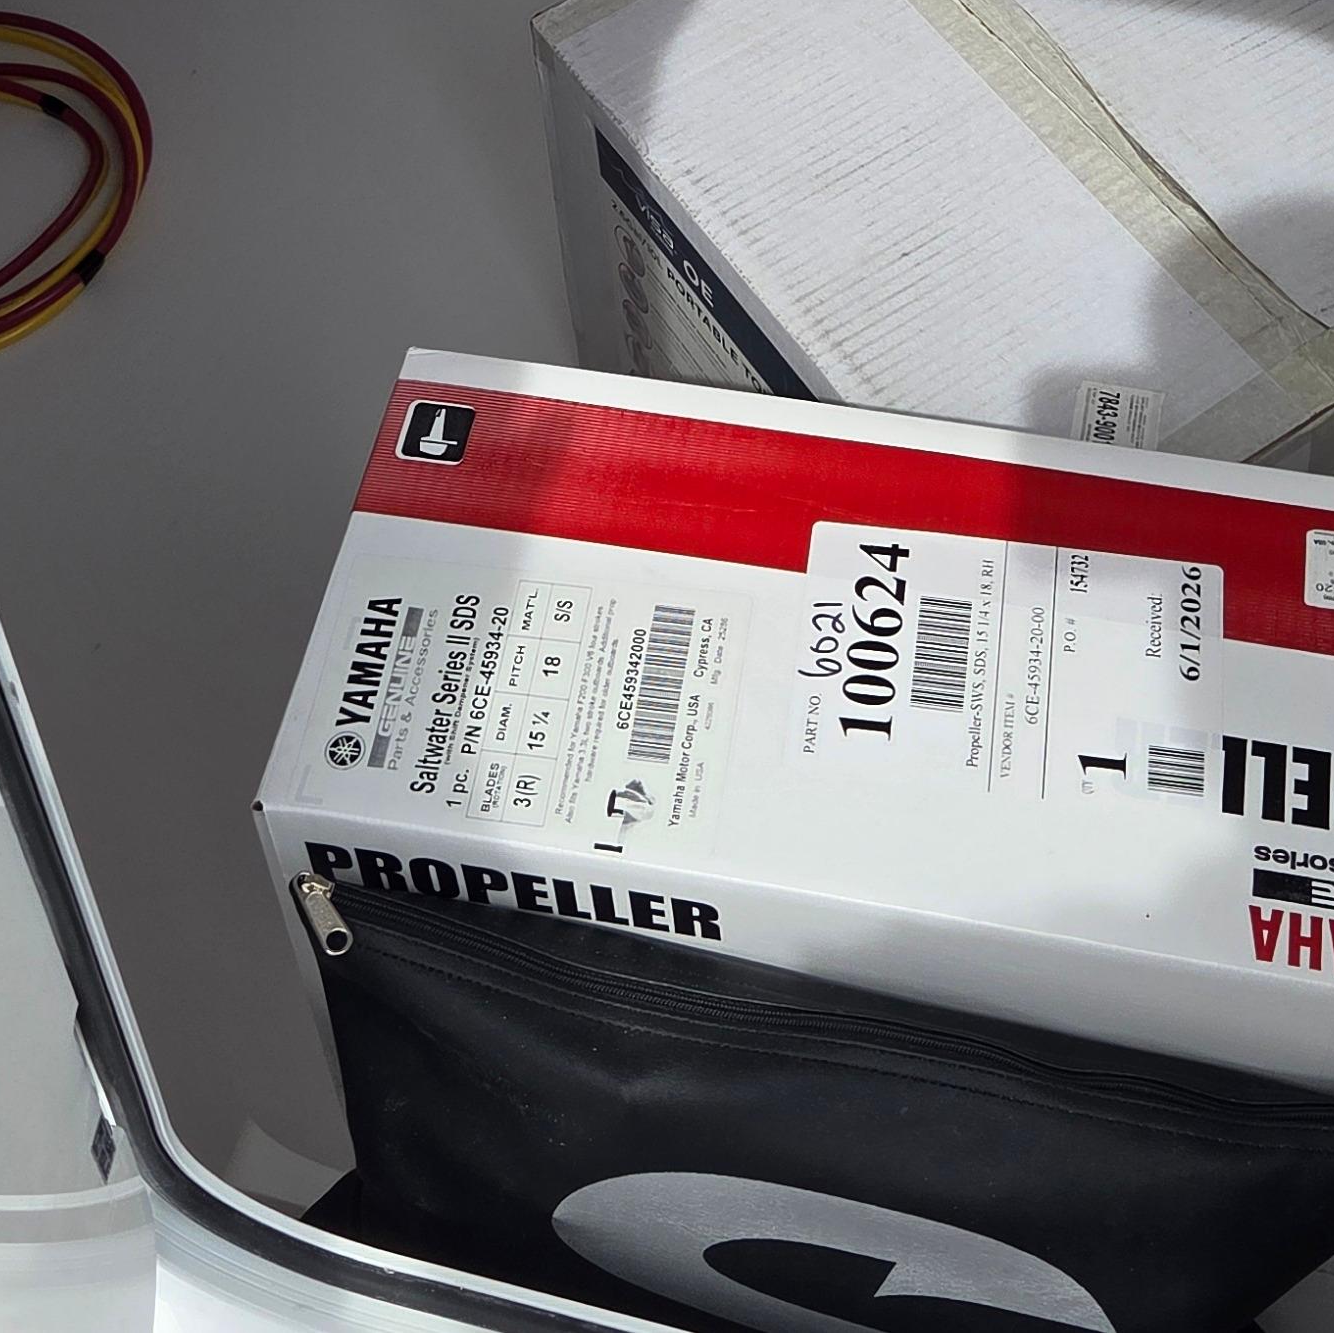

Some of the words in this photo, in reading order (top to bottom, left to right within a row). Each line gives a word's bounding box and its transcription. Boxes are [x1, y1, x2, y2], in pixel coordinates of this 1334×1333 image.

[667, 267, 737, 361] PORTABLE
[981, 559, 995, 577] RH
[1069, 553, 1088, 593] 154732
[449, 594, 481, 630] SDS
[553, 599, 573, 622] S/S
[700, 617, 712, 632] CA
[977, 609, 991, 625] 1/4
[1145, 592, 1163, 658] Received:
[1178, 565, 1202, 681] 6/1/2026
[445, 634, 471, 645] II
[798, 598, 843, 680] 6021
[836, 539, 910, 741] 100624
[975, 630, 988, 642] 15
[1063, 628, 1077, 652] P.O.
[335, 597, 403, 727] YAMAHA
[405, 609, 438, 707] Accessories
[469, 606, 509, 720] 6CE-45934-20
[508, 645, 525, 686] PITCH
[541, 655, 560, 677] 18
[692, 634, 711, 678] Cypress,
[972, 646, 989, 675] SDS,
[1023, 606, 1045, 725] 6CE-45934-20-00
[378, 636, 417, 736] GENUINE
[431, 650, 467, 704] Series
[615, 627, 647, 729] 6CE459342000
[401, 711, 412, 724] &
[495, 702, 512, 740] DIAM.
[686, 694, 700, 716] USA
[807, 692, 821, 715] NO.
[966, 678, 986, 767] Propeller-SWS,
[1003, 700, 1016, 728] ITEM
[387, 728, 409, 770] Parts
[410, 708, 451, 793] Saltwater
[460, 724, 482, 755] P/N
[526, 730, 546, 750] 15
[803, 716, 818, 753] PART
[1000, 731, 1012, 777] VENDOR
[451, 767, 472, 794] pc.
[675, 752, 690, 781] Motor
[1075, 748, 1128, 779] 1
[445, 798, 461, 809] 1
[481, 762, 499, 812] BLADES
[668, 785, 685, 827] Yamaha
[303, 841, 722, 941] PROPELLER
